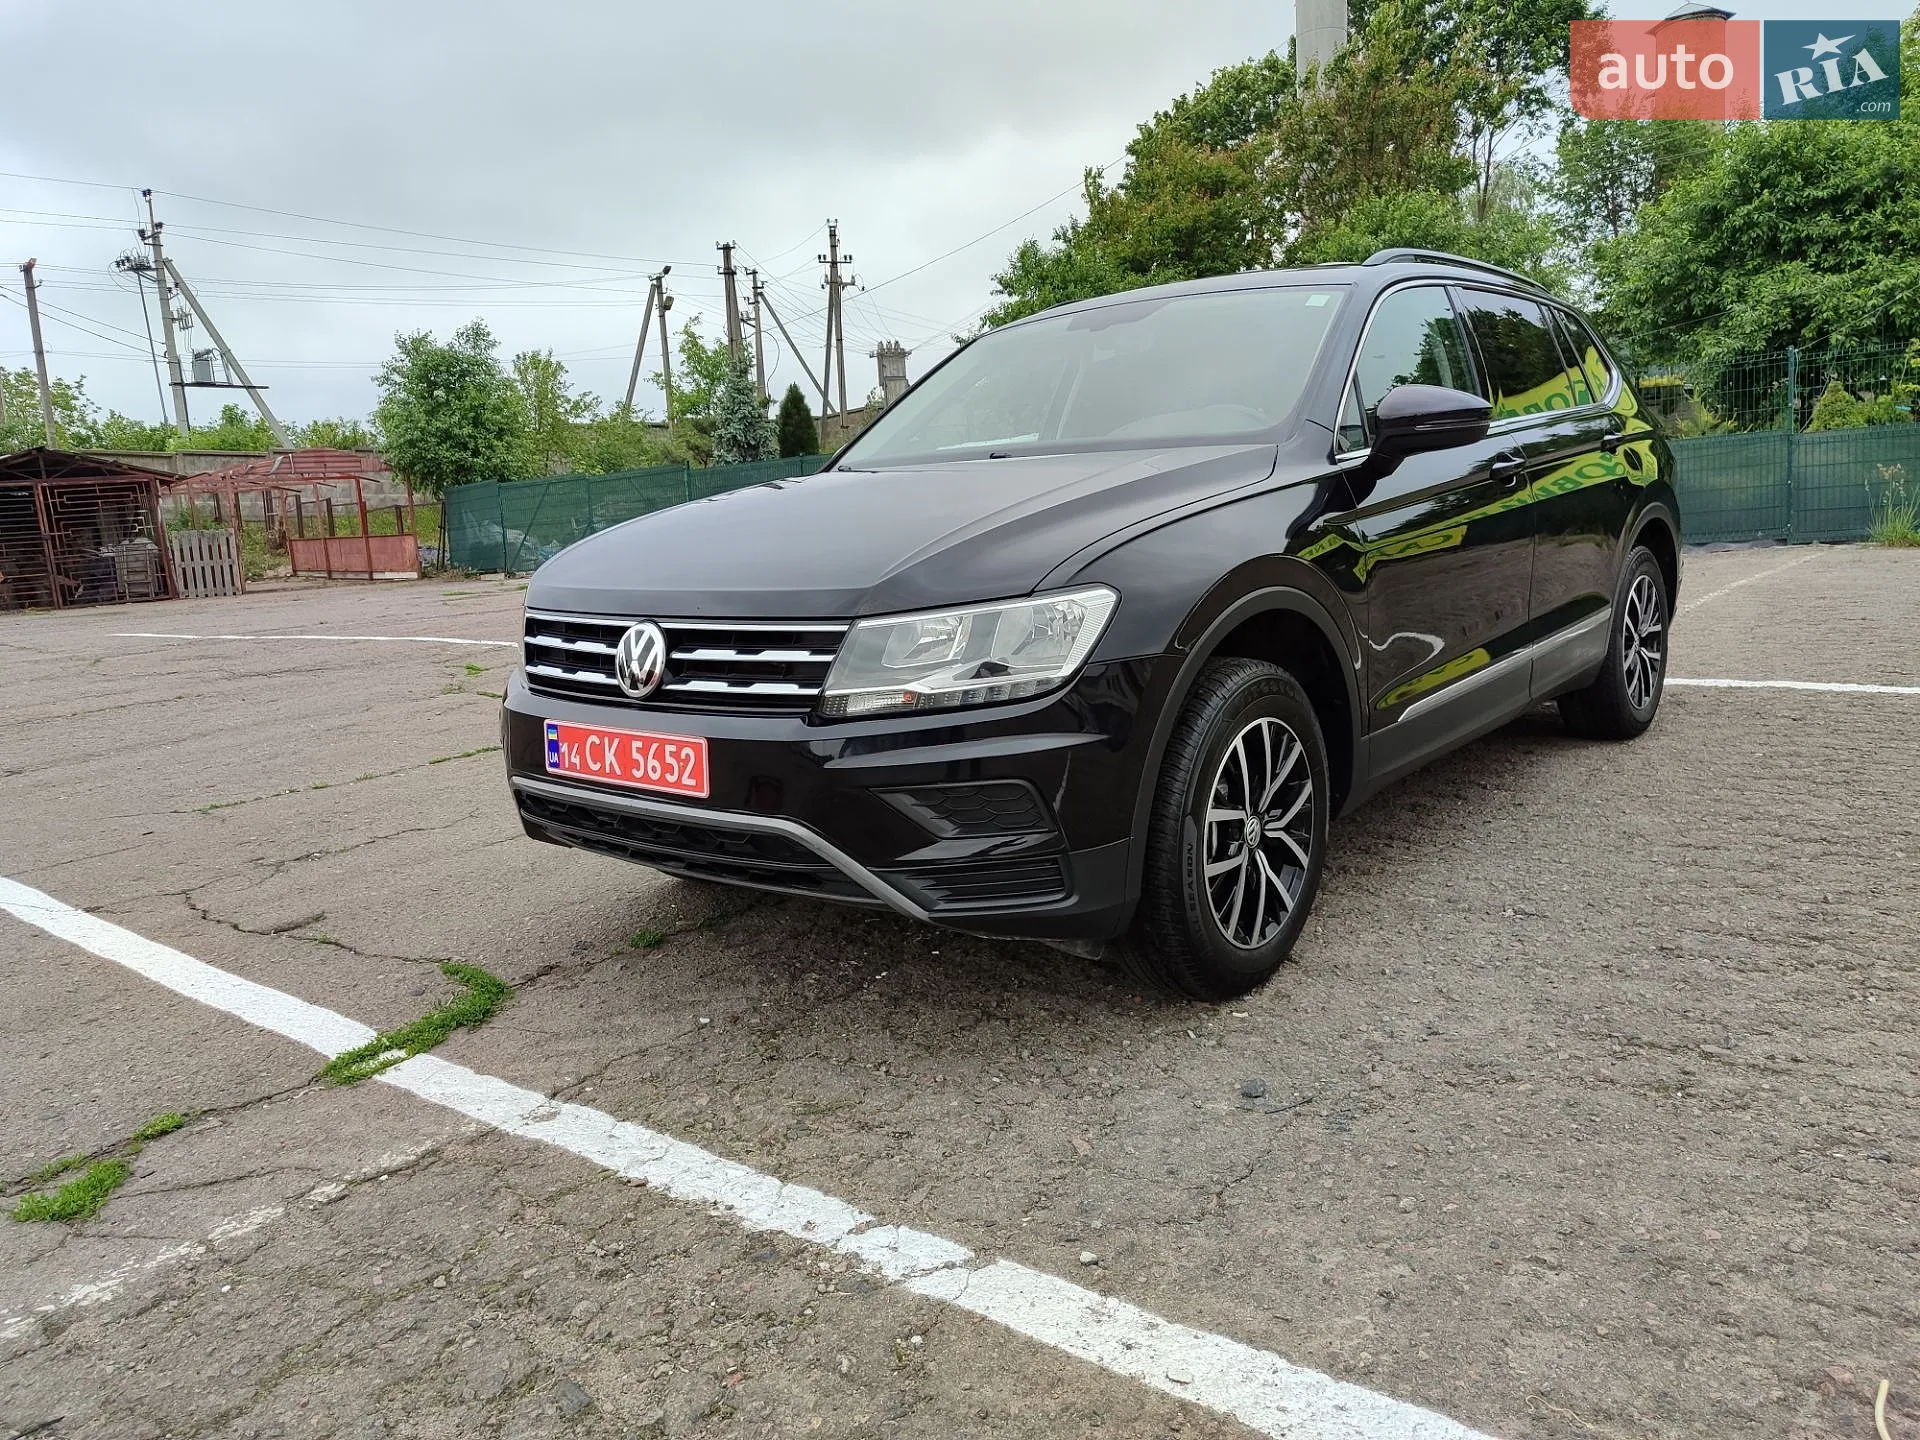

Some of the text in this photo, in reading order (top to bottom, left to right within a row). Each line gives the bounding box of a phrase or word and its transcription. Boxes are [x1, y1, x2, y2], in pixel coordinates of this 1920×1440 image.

[549, 751, 560, 764] UA
[585, 734, 622, 776] CK
[631, 739, 697, 787] 5652
[1186, 842, 1197, 913] SEASON
